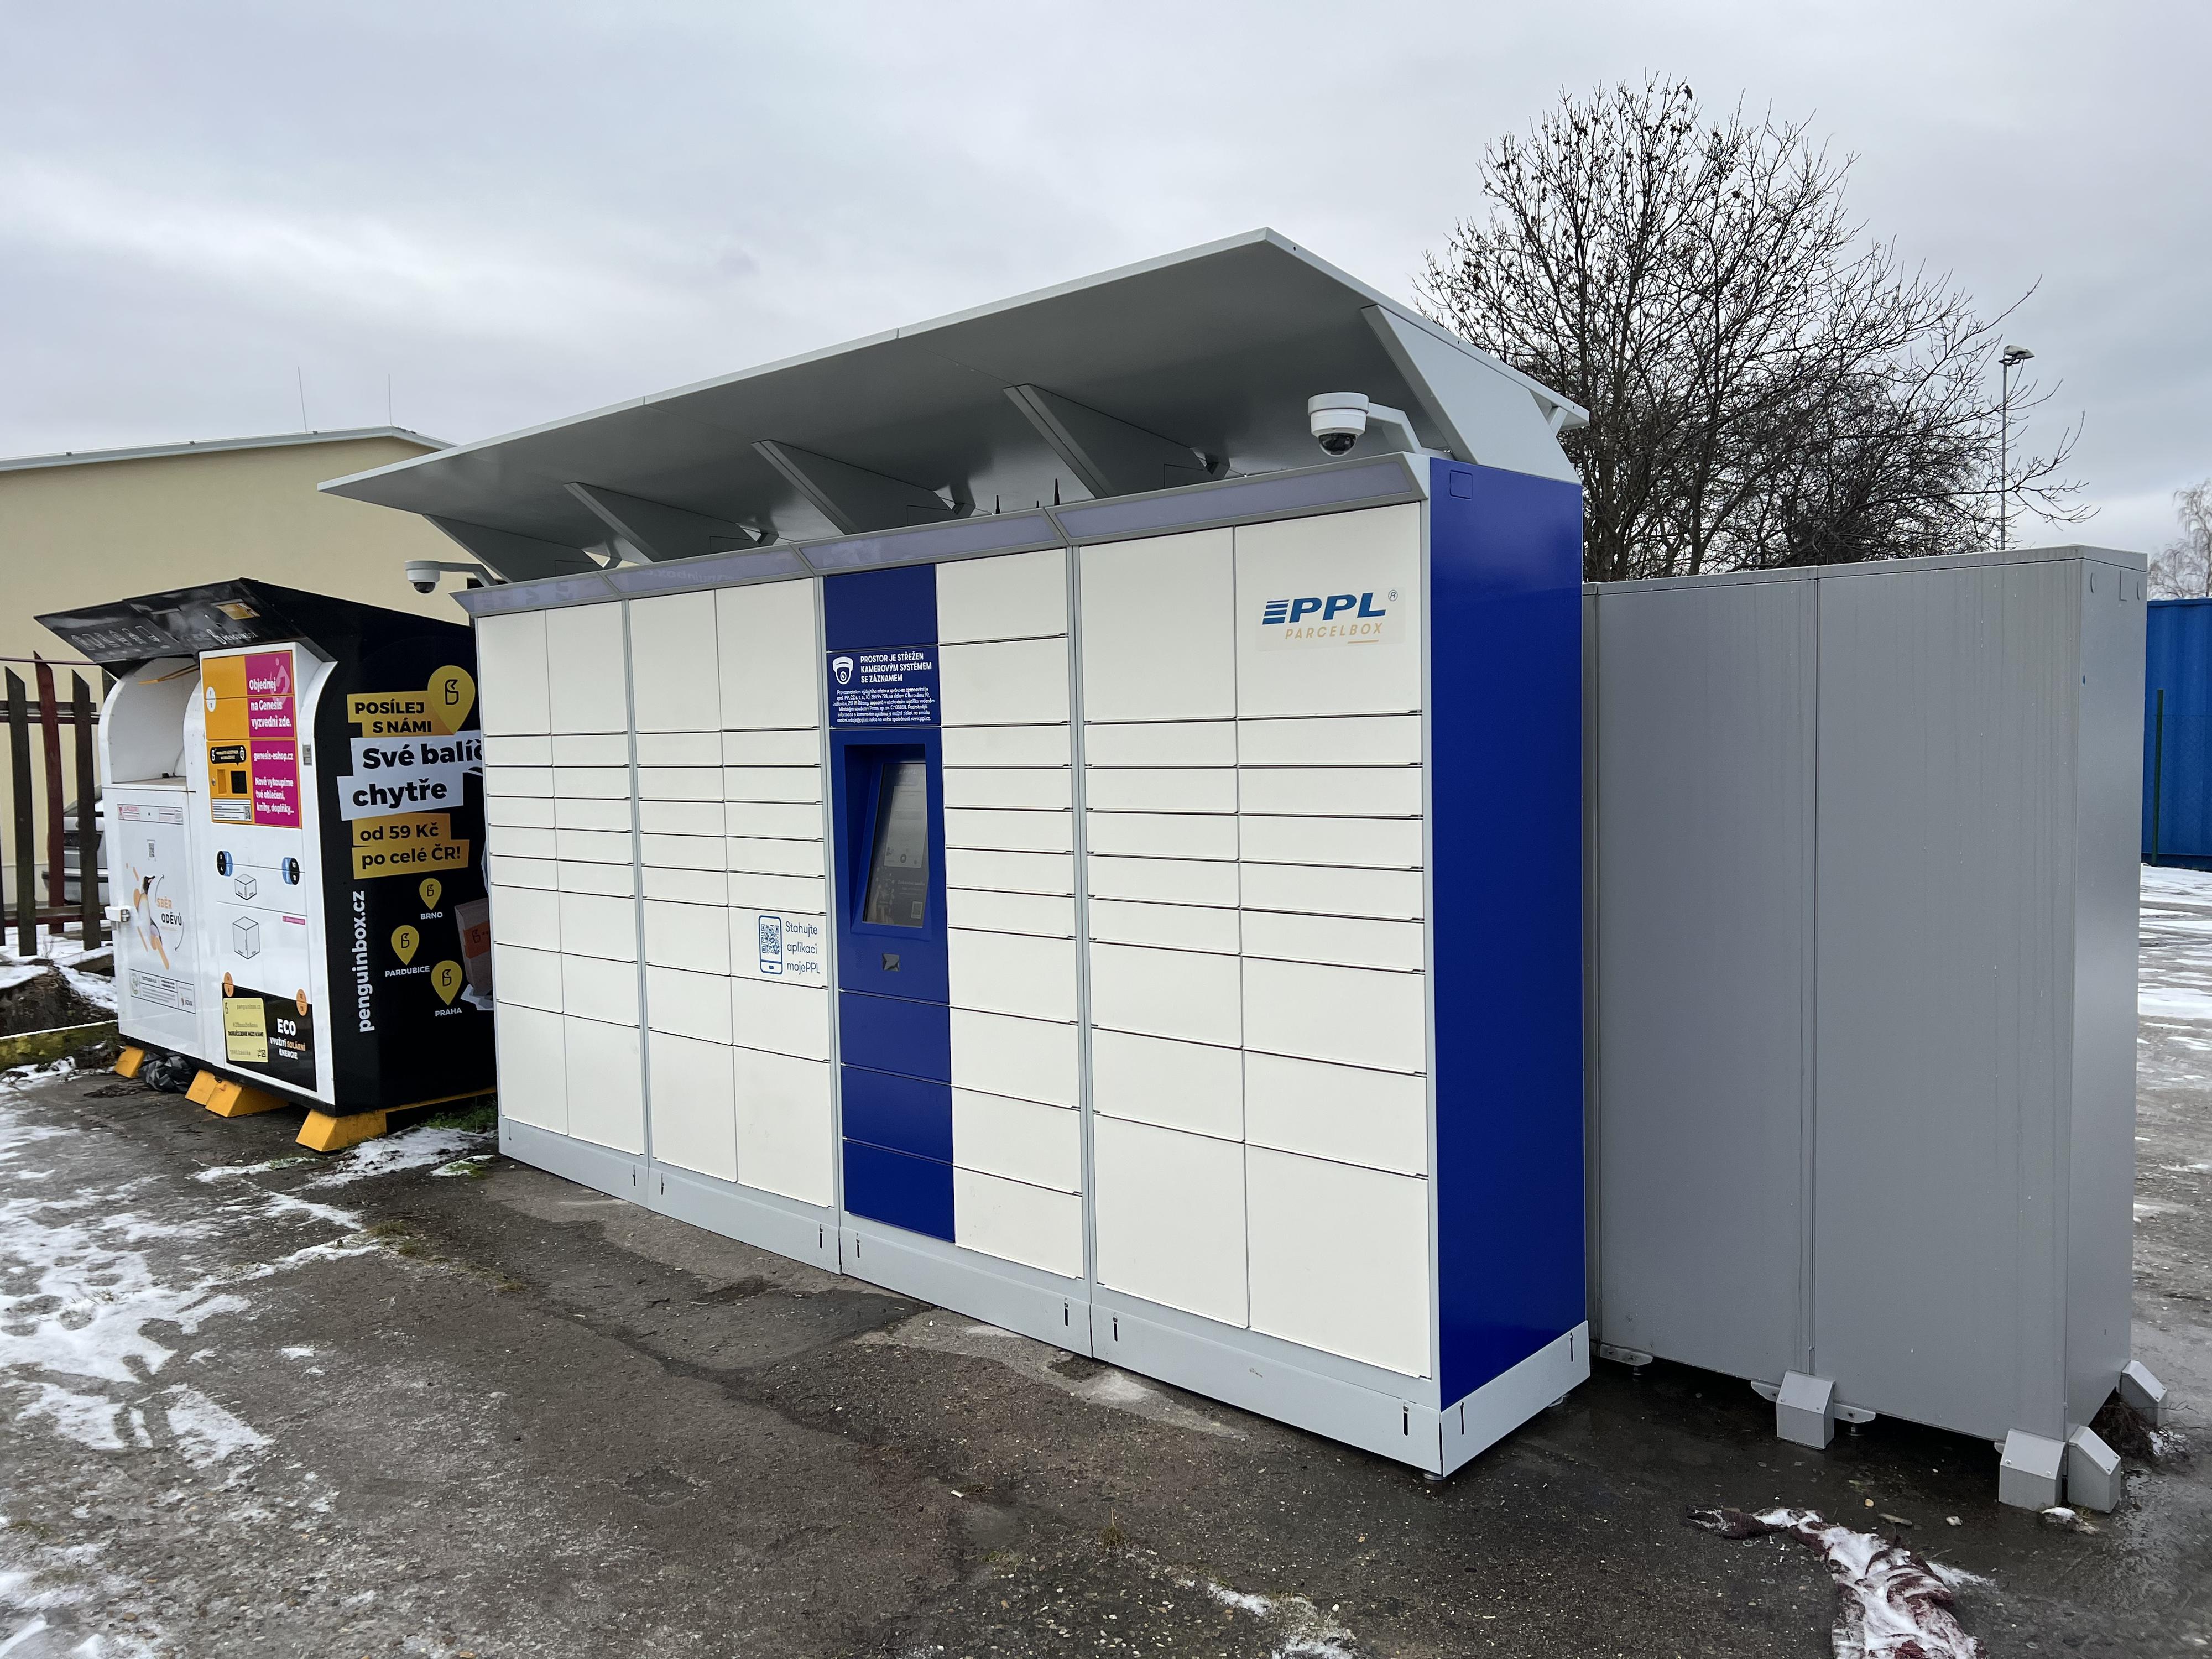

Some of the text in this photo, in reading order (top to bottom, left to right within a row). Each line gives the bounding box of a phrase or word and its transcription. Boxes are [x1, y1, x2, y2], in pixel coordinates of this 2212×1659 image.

[1289, 592, 1386, 623] PPL
[1285, 622, 1383, 639] PARCELBOX
[860, 651, 924, 663] PROSTOR JE STŘEŽEN
[860, 662, 932, 673] KAMEROVÝM SYSTÉMEM
[249, 677, 276, 692] Objednej
[869, 673, 903, 683] ZÁZNAMEM
[251, 699, 283, 711] na Genesis
[354, 698, 424, 714] POSÍLEJ
[251, 715, 292, 730] vyzvedni zde.
[372, 717, 432, 733] S NÁMI
[253, 750, 294, 761] genesis-eshop.cz
[362, 744, 415, 769] Své
[352, 778, 447, 810] chytře
[360, 822, 439, 841] od 59 Kč
[362, 843, 461, 870] po celé ČR!
[156, 896, 172, 909] SBĚR
[161, 911, 182, 926] ODĚVŮ
[420, 912, 443, 920] BRNO
[785, 921, 818, 937] Stahujte
[787, 941, 817, 955] aplikaci
[352, 890, 375, 1032] penguinbox.cz
[787, 961, 820, 975] mojePPL
[385, 966, 430, 977] PARDUBICE
[435, 1008, 462, 1017] PRAHA
[277, 1018, 296, 1036] ECO
[269, 1037, 286, 1047] VYUŽITÍ
